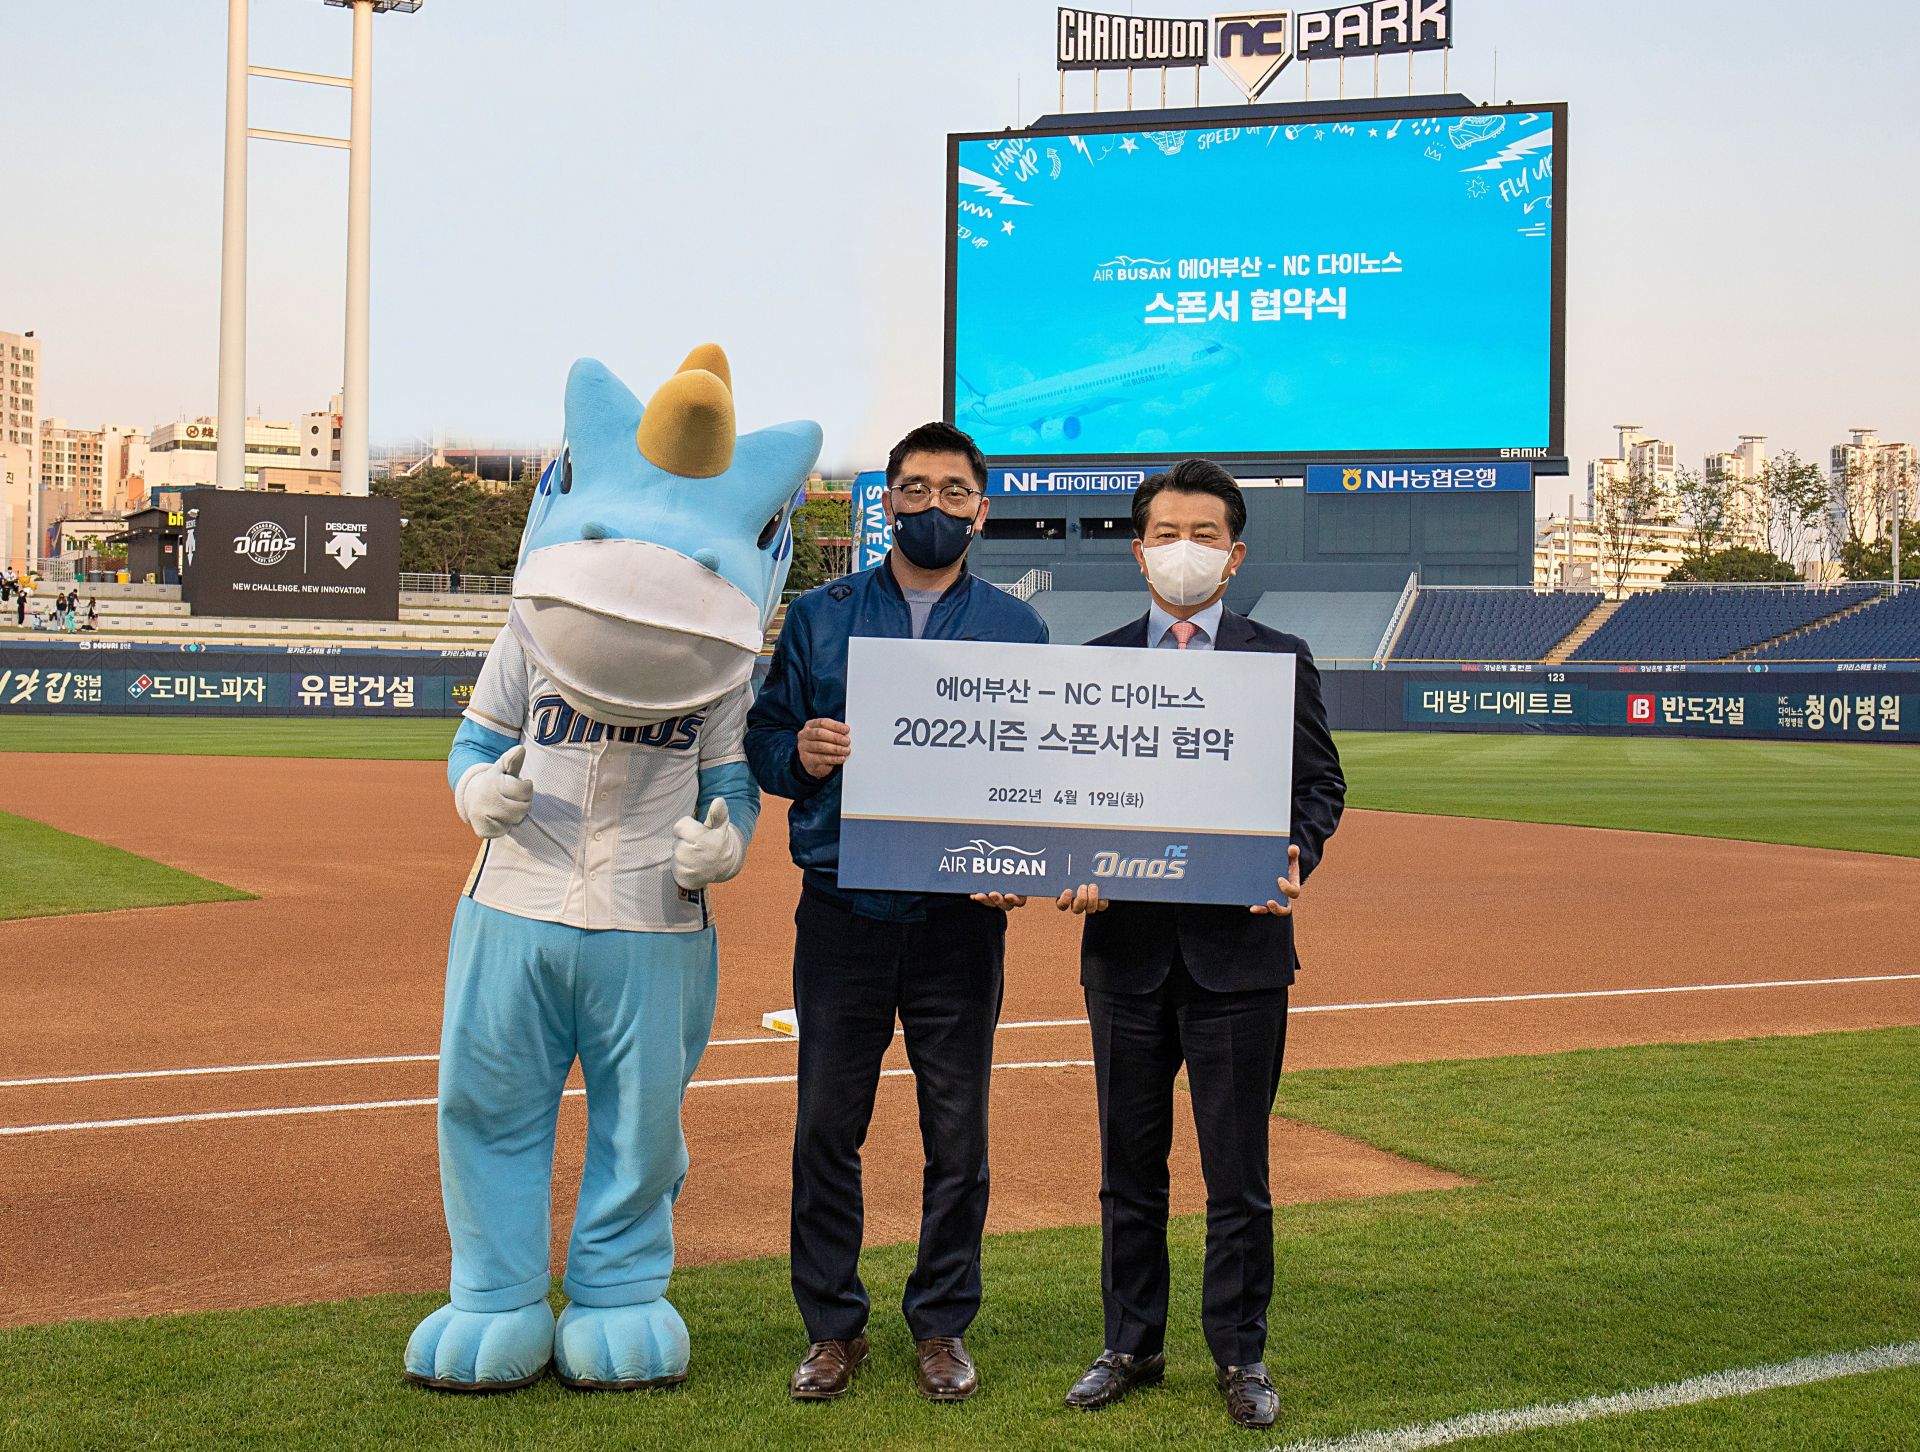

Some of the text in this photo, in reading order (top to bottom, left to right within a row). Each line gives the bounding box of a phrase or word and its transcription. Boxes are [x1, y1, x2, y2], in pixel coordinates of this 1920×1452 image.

[1060, 9, 1205, 61] CHANGWON
[1299, 0, 1447, 50] PARK
[1197, 128, 1241, 150] SPEED
[1015, 147, 1039, 183] UP
[1499, 167, 1530, 202] FLY
[1093, 270, 1114, 281] AIR
[1117, 267, 1171, 281] BUSAN
[1178, 257, 1262, 279] 에어부산
[1283, 255, 1310, 276] NC
[1317, 251, 1403, 275] 다이노스
[1144, 287, 1347, 324] 스폰서 협약식
[1500, 448, 1548, 458] SAMIK
[1366, 468, 1497, 489] NH농협은행
[325, 523, 368, 532] DESCENTE
[232, 583, 366, 594] NEW CHALLENGE, NEW INNOVATION
[0, 669, 72, 704] 갓집
[73, 674, 102, 688] 양념
[150, 675, 266, 703] 도미노피자
[1547, 673, 1565, 682] 123
[73, 689, 102, 702] 치킨
[298, 675, 414, 709] 유탑건설
[936, 676, 1031, 705] 에어부산
[1064, 683, 1102, 706] NC
[1111, 684, 1206, 710] 다이노스
[1423, 691, 1573, 715] 대방 디에트르
[1778, 696, 1789, 705] NC
[1661, 696, 1745, 725] 반도건설
[1778, 707, 1804, 716] 다이노스
[1778, 717, 1804, 727] 지정병원
[1804, 694, 1900, 731] 청아병원
[893, 717, 1234, 761] 2022시즌 스폰서십 협약
[988, 787, 1145, 810] 2022년 4월 19일(화)
[938, 856, 1047, 877] AIR BUSAN
